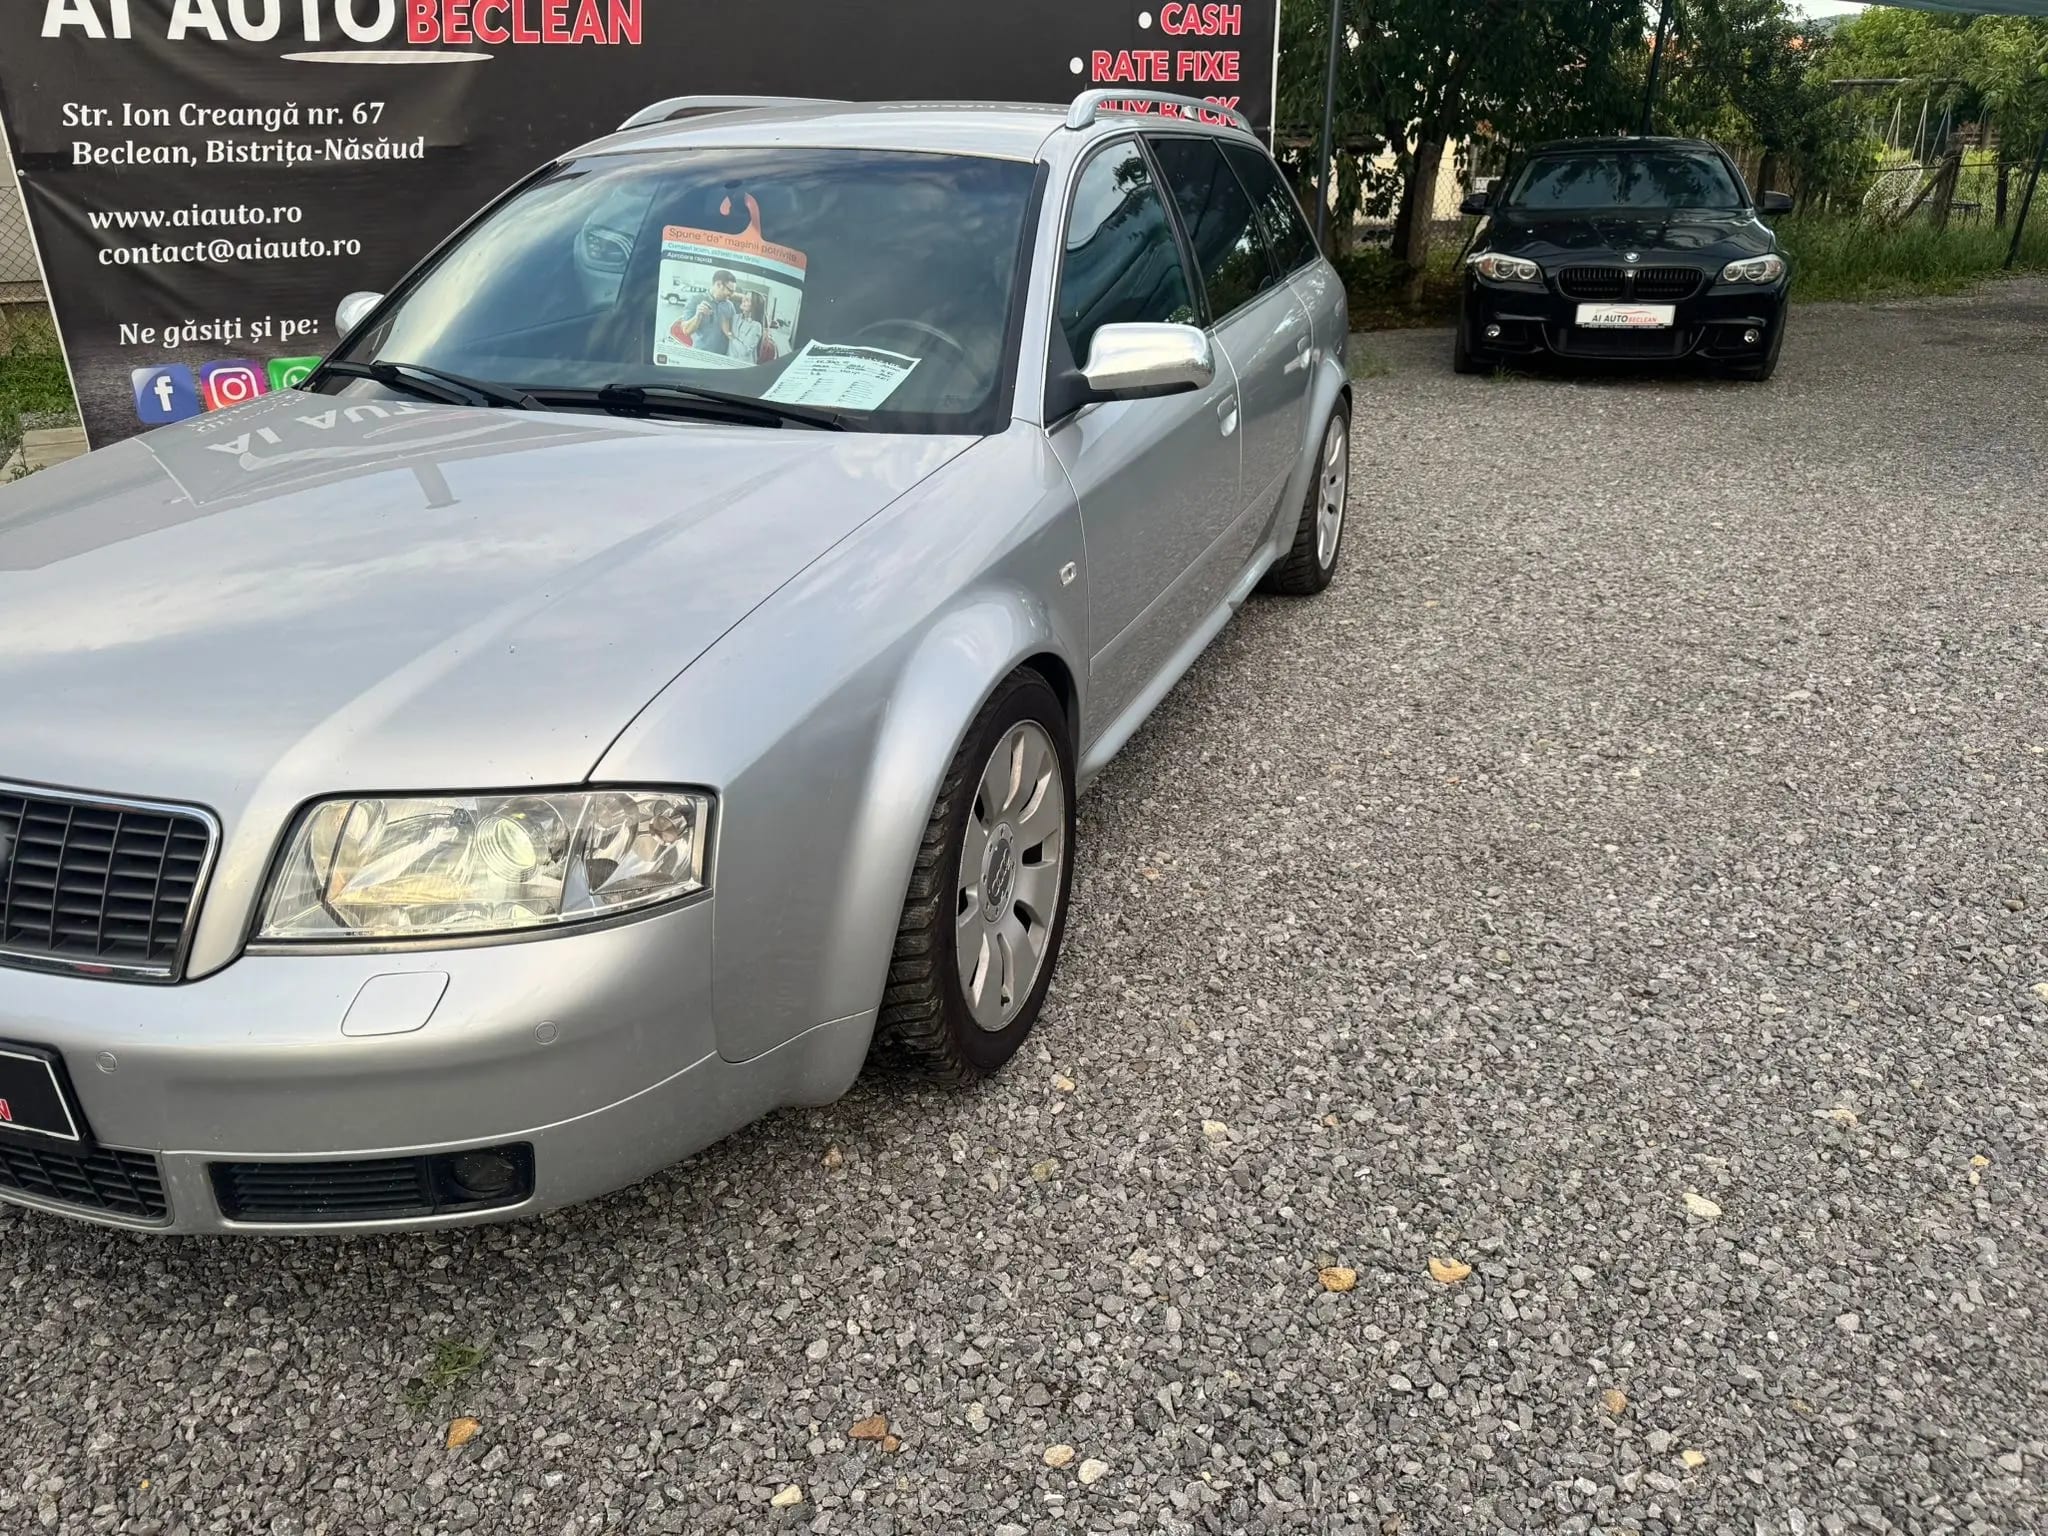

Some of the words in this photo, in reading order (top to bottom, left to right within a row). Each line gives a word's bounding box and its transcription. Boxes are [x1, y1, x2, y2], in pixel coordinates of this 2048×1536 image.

[406, 0, 642, 44] BECLEAN
[1160, 2, 1241, 35] CASH
[1092, 50, 1169, 82] RATE
[1177, 50, 1240, 82] FIXE
[62, 102, 113, 126] Str.
[122, 103, 171, 126] Ion
[179, 101, 299, 132] Creangă
[308, 107, 343, 125] nr.
[352, 101, 385, 124] 67
[72, 140, 197, 167] Beclean,
[206, 136, 424, 168] Bistrița-Năsăud
[88, 204, 302, 230] www.aiauto.ro
[668, 227, 701, 241] Spune
[98, 237, 361, 266] contact@aiauto.ro
[119, 323, 155, 346] Ne
[163, 316, 242, 348] găsiți
[250, 316, 272, 344] și
[280, 318, 318, 342] pe:
[1604, 315, 1628, 323] AUTO
